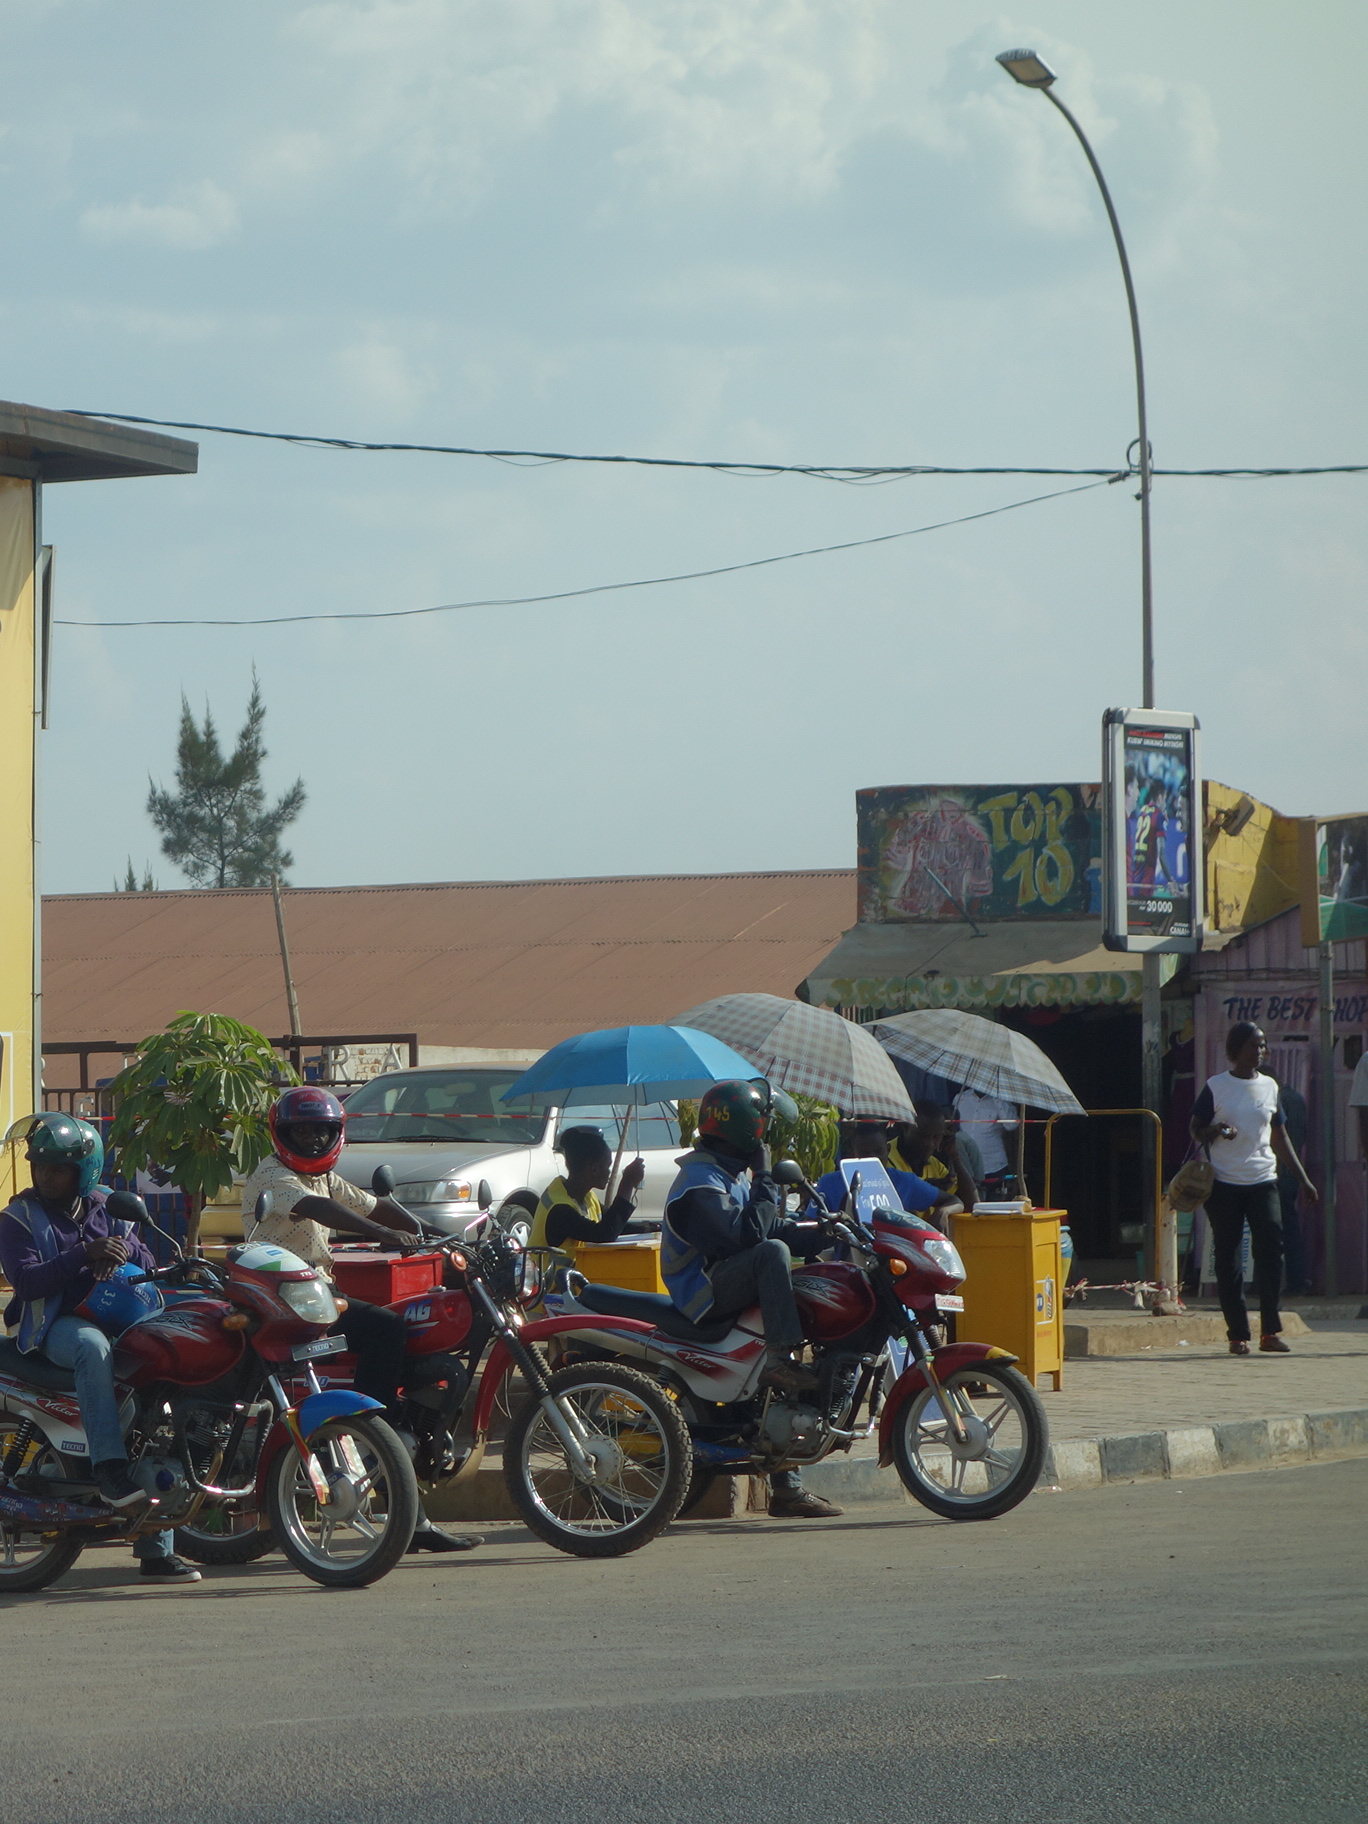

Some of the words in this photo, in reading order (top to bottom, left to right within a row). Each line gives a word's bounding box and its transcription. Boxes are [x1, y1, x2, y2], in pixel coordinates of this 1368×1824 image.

[978, 787, 1074, 850] TOP
[1001, 842, 1075, 906] 10
[1223, 996, 1263, 1021] THE
[1267, 995, 1318, 1021] BEST
[1333, 994, 1368, 1023] HOP
[404, 1299, 432, 1322] AG
[683, 1351, 717, 1370] Victor
[45, 1399, 79, 1417] Victor
[62, 1442, 84, 1451] TECNO
